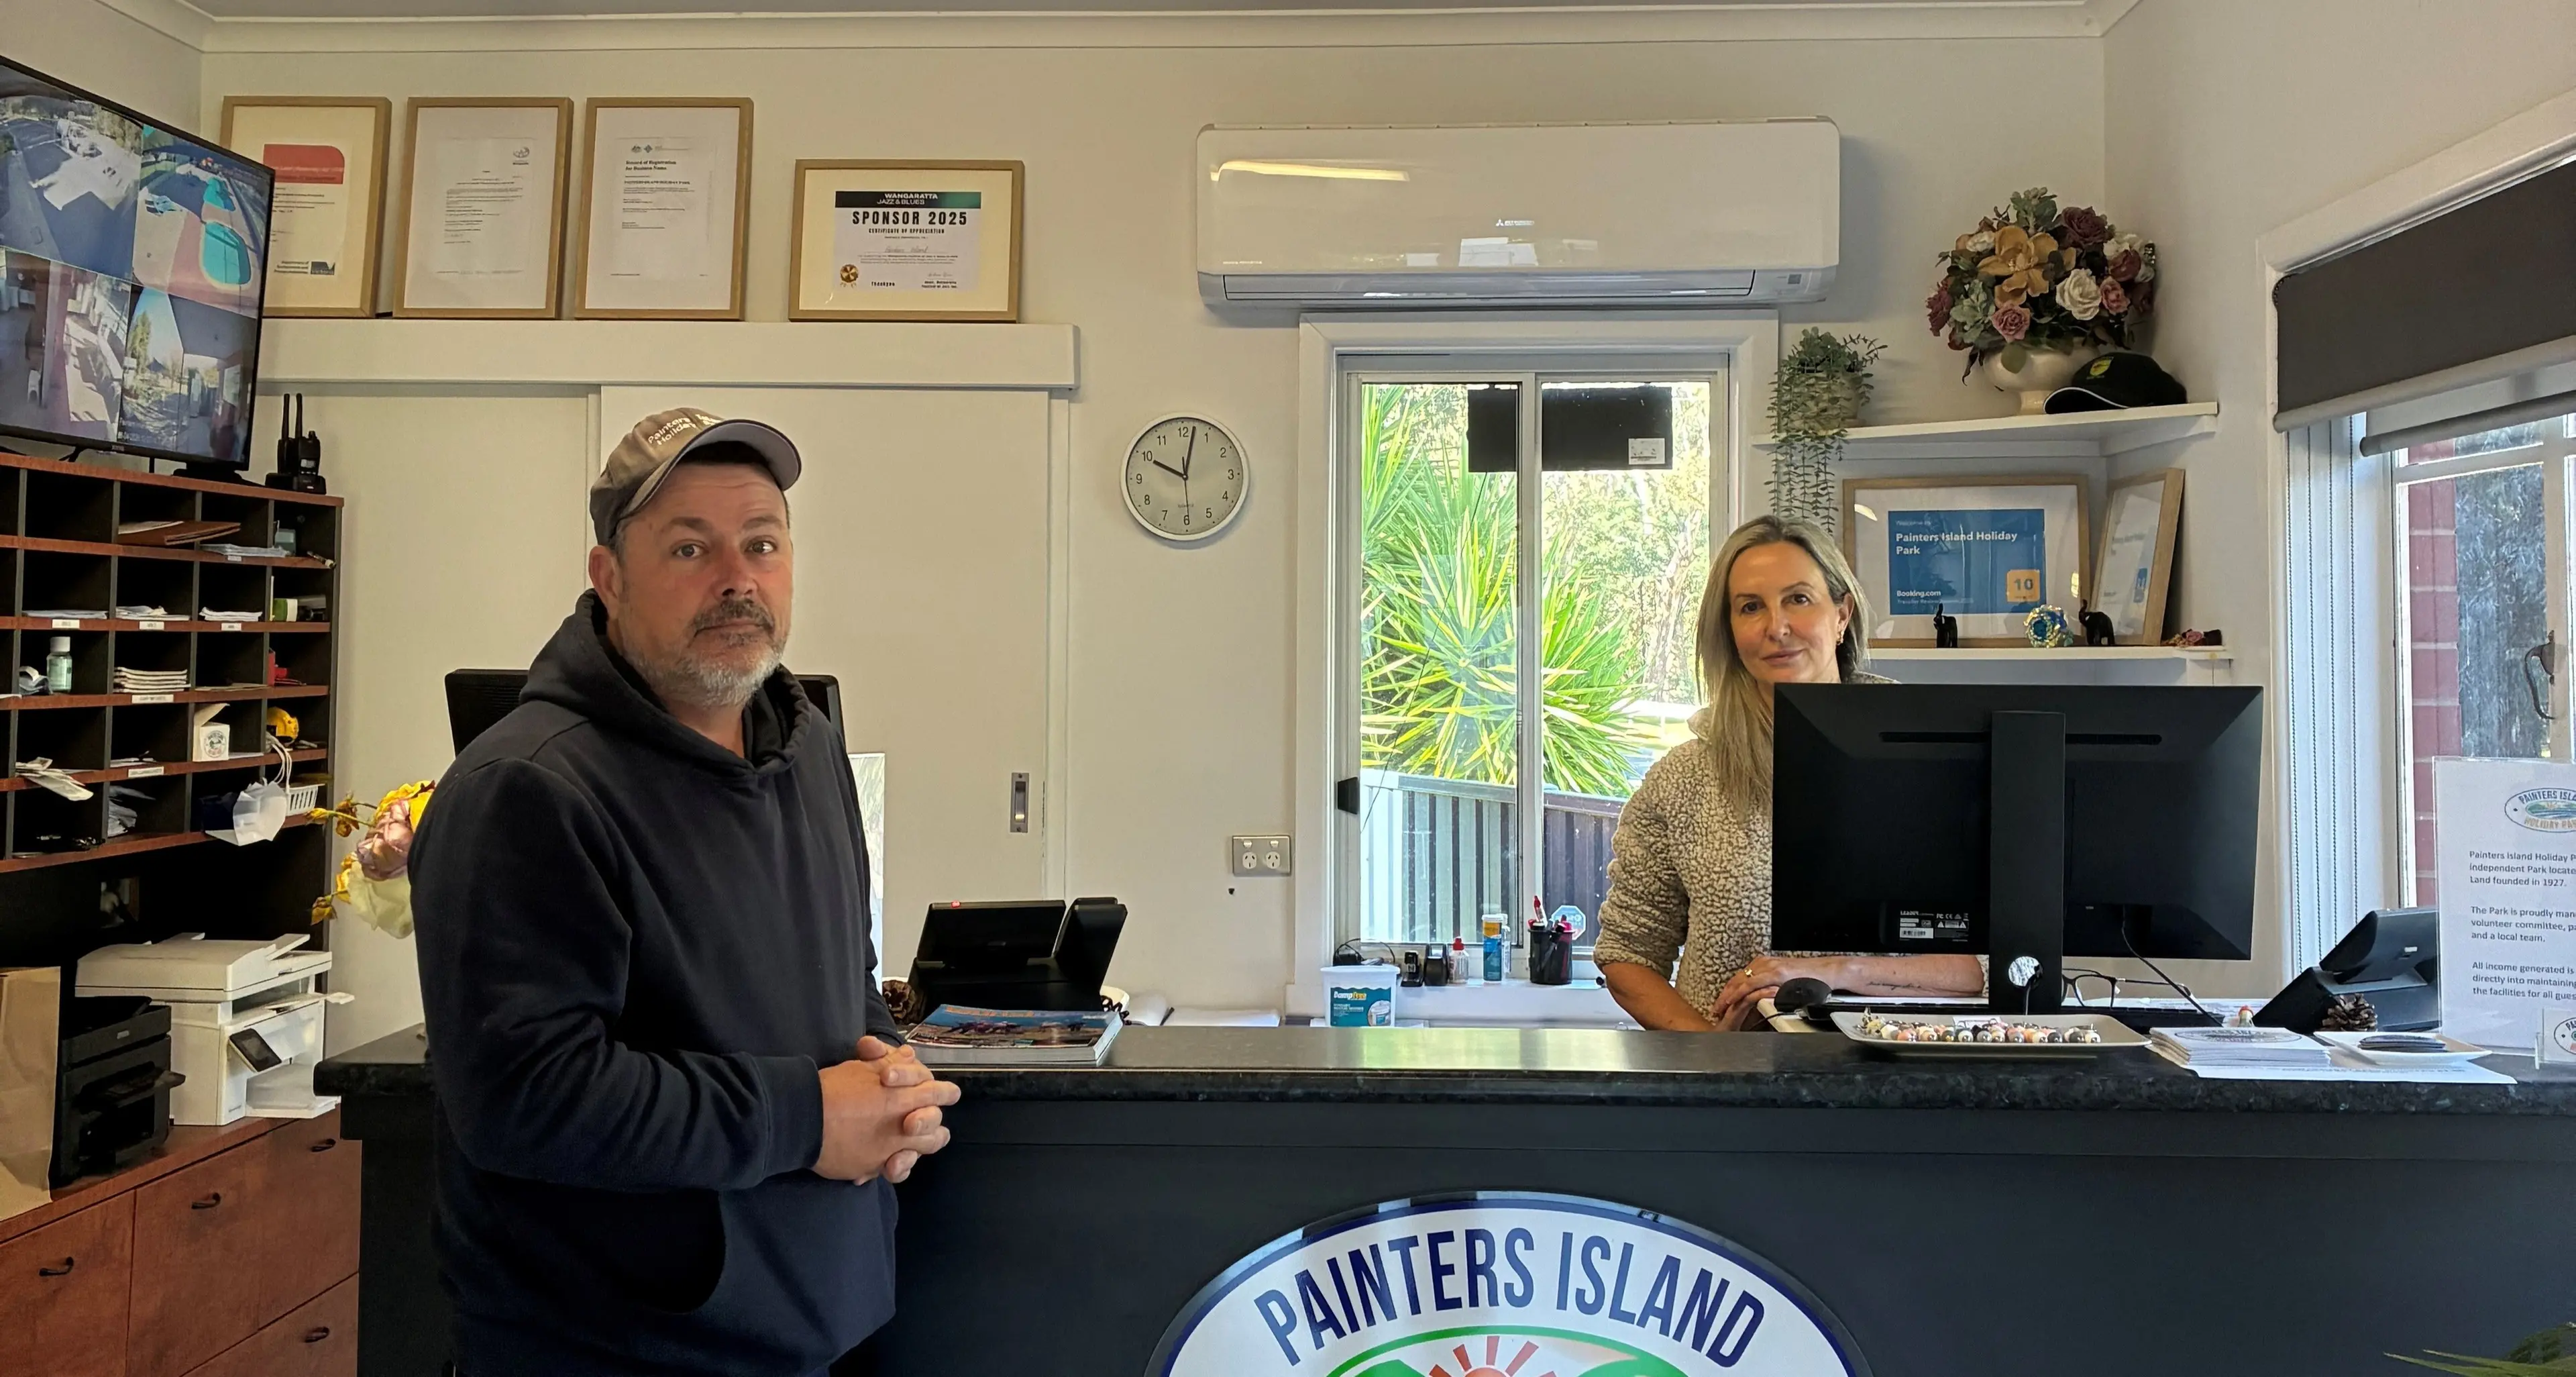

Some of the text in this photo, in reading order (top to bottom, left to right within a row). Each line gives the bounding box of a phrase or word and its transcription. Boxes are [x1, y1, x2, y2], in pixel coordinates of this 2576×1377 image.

[852, 211, 967, 225] SPONSOR 2025
[647, 417, 692, 444] Painters
[656, 422, 698, 446] Holiday
[1177, 427, 1189, 438] 12
[1157, 435, 1167, 446] 11
[1204, 432, 1209, 443] 1
[1142, 450, 1152, 462] 10
[1220, 447, 1227, 458] 2
[1135, 473, 1142, 484] 9
[1227, 469, 1234, 480] 3
[1144, 495, 1150, 505] 8
[1222, 491, 1229, 501] 4
[1161, 509, 1168, 521] 7
[1205, 507, 1212, 518] 5
[1183, 515, 1190, 525] 6
[1896, 530, 2018, 542] Painters Island Holiday
[1896, 545, 1921, 555] Park
[2015, 578, 2034, 591] 10
[1896, 590, 1941, 598] Booking.com
[2518, 790, 2558, 805] PAINTERS
[2524, 817, 2559, 829] HOLIDAY
[2469, 850, 2505, 860] Painters
[2507, 852, 2533, 861] Island
[2535, 854, 2568, 864] Holiday
[2527, 865, 2547, 874] Park
[2469, 876, 2567, 887] Land founded in 1927.
[2471, 906, 2487, 915] The
[2489, 907, 2509, 915] Park
[2510, 907, 2518, 916] is
[2519, 909, 2553, 919] proudly
[2471, 919, 2513, 928] volunteer
[2515, 921, 2566, 932] committee,
[2471, 931, 2487, 940] and
[2498, 932, 2518, 941] local
[2472, 961, 2575, 974] All income generated is
[2472, 974, 2506, 985] directly
[2507, 976, 2525, 984] into
[2473, 987, 2488, 995] the
[2489, 988, 2526, 997] facilities
[2528, 989, 2540, 998] for
[2542, 990, 2553, 999] all
[1253, 1226, 1765, 1368] PAINTERS ISLAND
